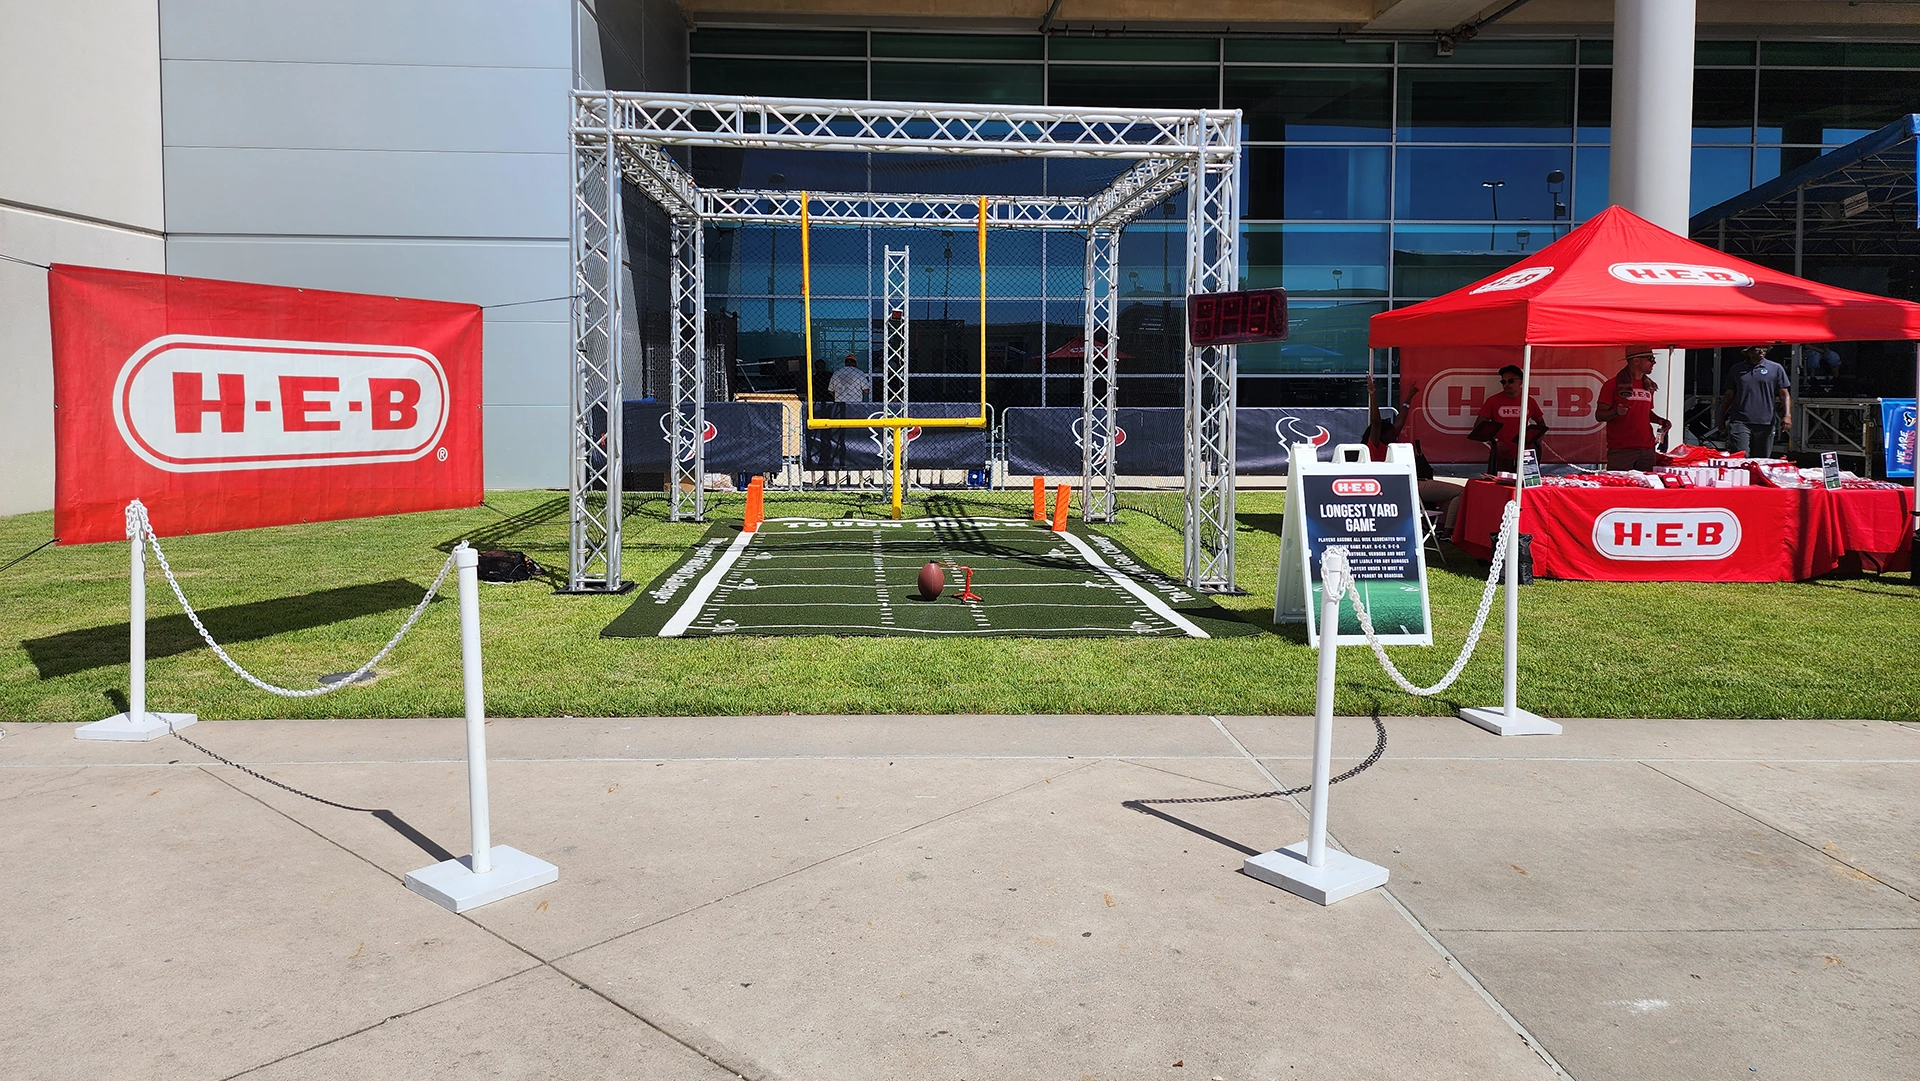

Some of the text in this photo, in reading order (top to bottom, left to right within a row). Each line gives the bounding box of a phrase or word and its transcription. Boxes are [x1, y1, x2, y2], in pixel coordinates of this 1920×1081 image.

[1626, 268, 1736, 283] H-E-B
[172, 371, 422, 434] H-E-B
[1337, 482, 1376, 493] H-E-B
[1320, 503, 1399, 518] LONGEST YARD
[783, 521, 903, 529] TOUCH
[1345, 518, 1377, 532] GAME
[1613, 521, 1725, 547] H-E-B
